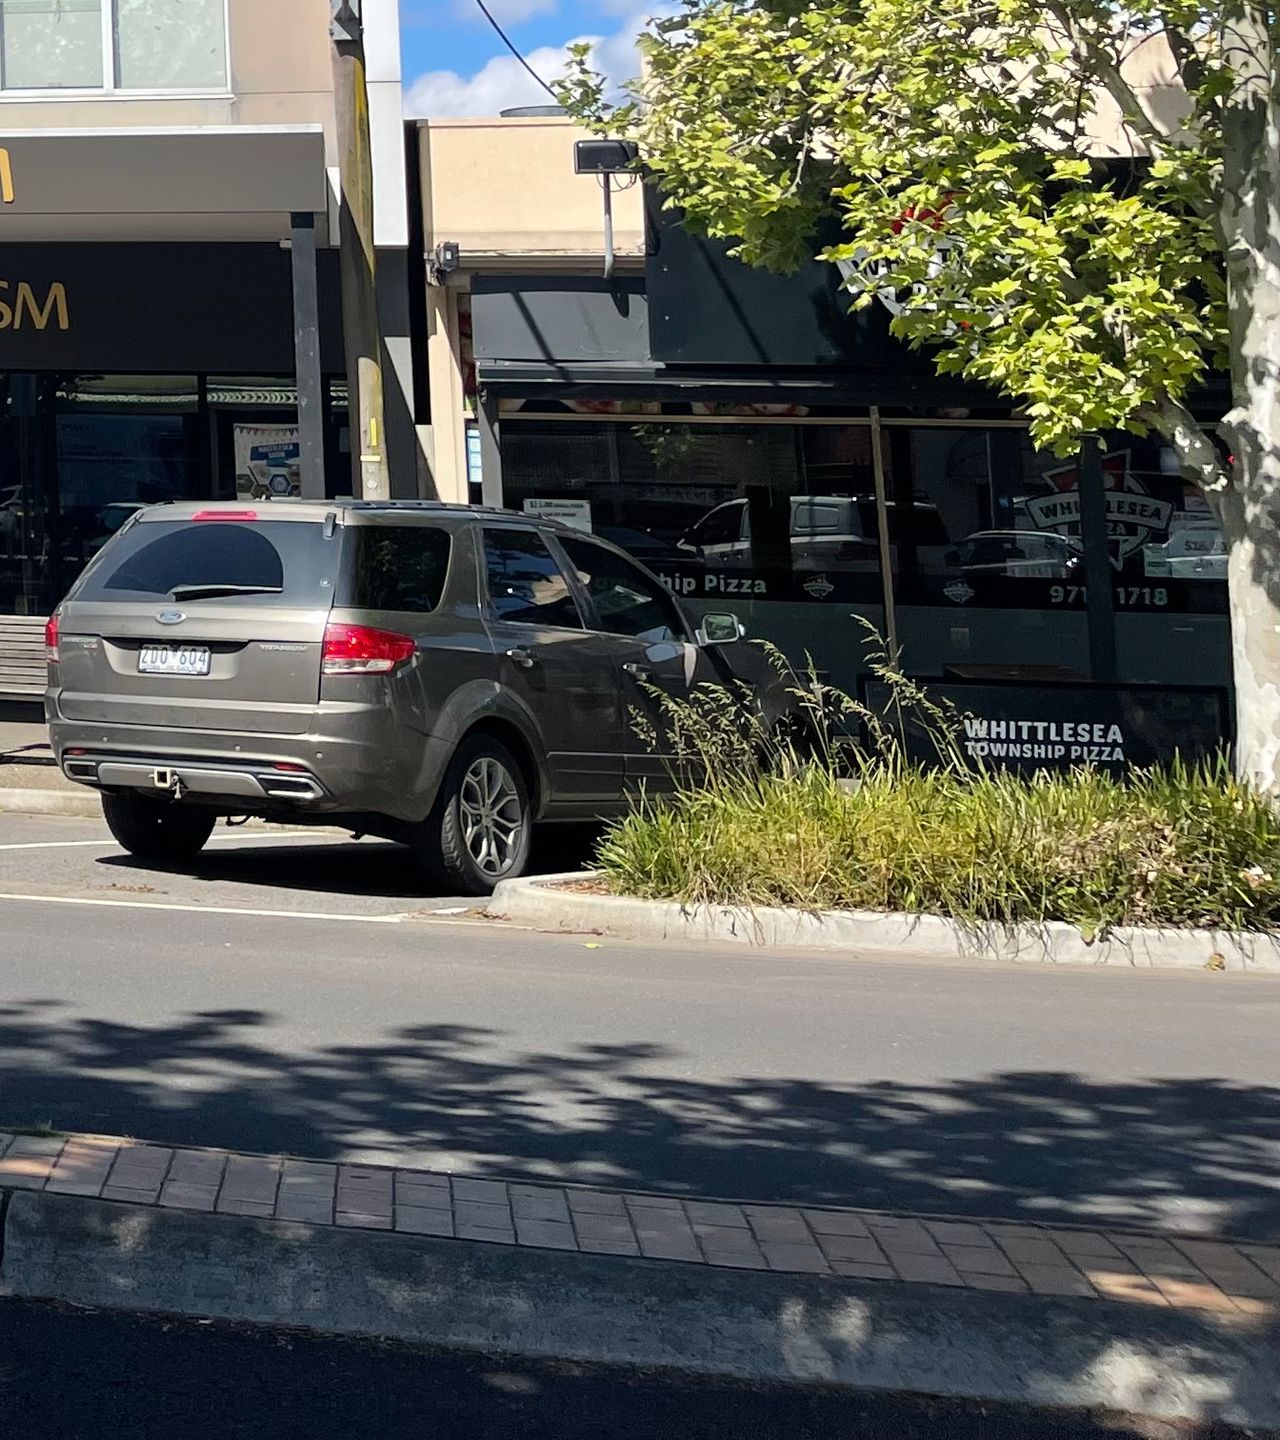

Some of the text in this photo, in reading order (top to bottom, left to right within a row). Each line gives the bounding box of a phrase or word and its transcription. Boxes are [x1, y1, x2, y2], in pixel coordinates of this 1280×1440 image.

[704, 574, 767, 594] Pizza
[1049, 585, 1168, 606] 971 1718
[963, 719, 1124, 744] WHITTLESEA
[964, 741, 1125, 761] TOWNSHIP PIZZA
